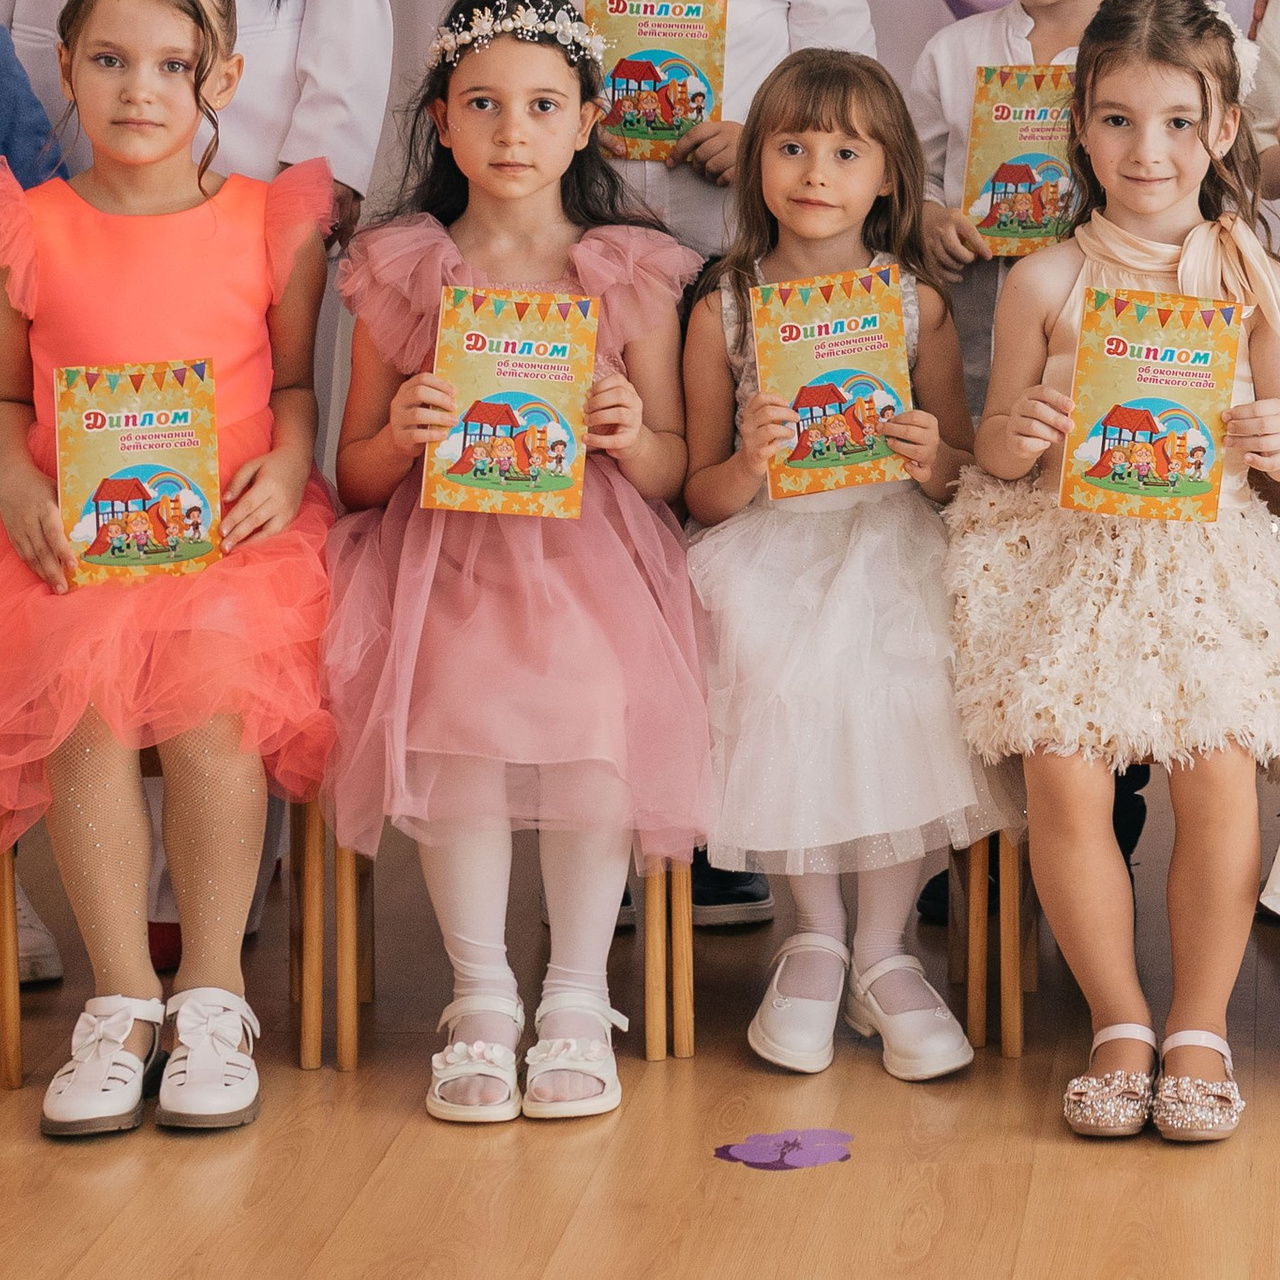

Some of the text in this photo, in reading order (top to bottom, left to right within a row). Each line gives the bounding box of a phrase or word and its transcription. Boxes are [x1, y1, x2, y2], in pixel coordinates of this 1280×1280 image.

[779, 315, 878, 343] Диплом
[465, 333, 568, 358] Диплом
[814, 334, 884, 351] об окончании
[815, 341, 889, 359] детского сада
[1105, 337, 1210, 365] Диплом
[497, 359, 570, 372] об окончании
[1138, 365, 1211, 379] об окончании
[496, 369, 574, 382] детского сада
[1137, 375, 1215, 389] детского сада
[84, 410, 190, 430] Диплом
[120, 431, 194, 442] об окончании
[120, 438, 199, 451] детского сада
